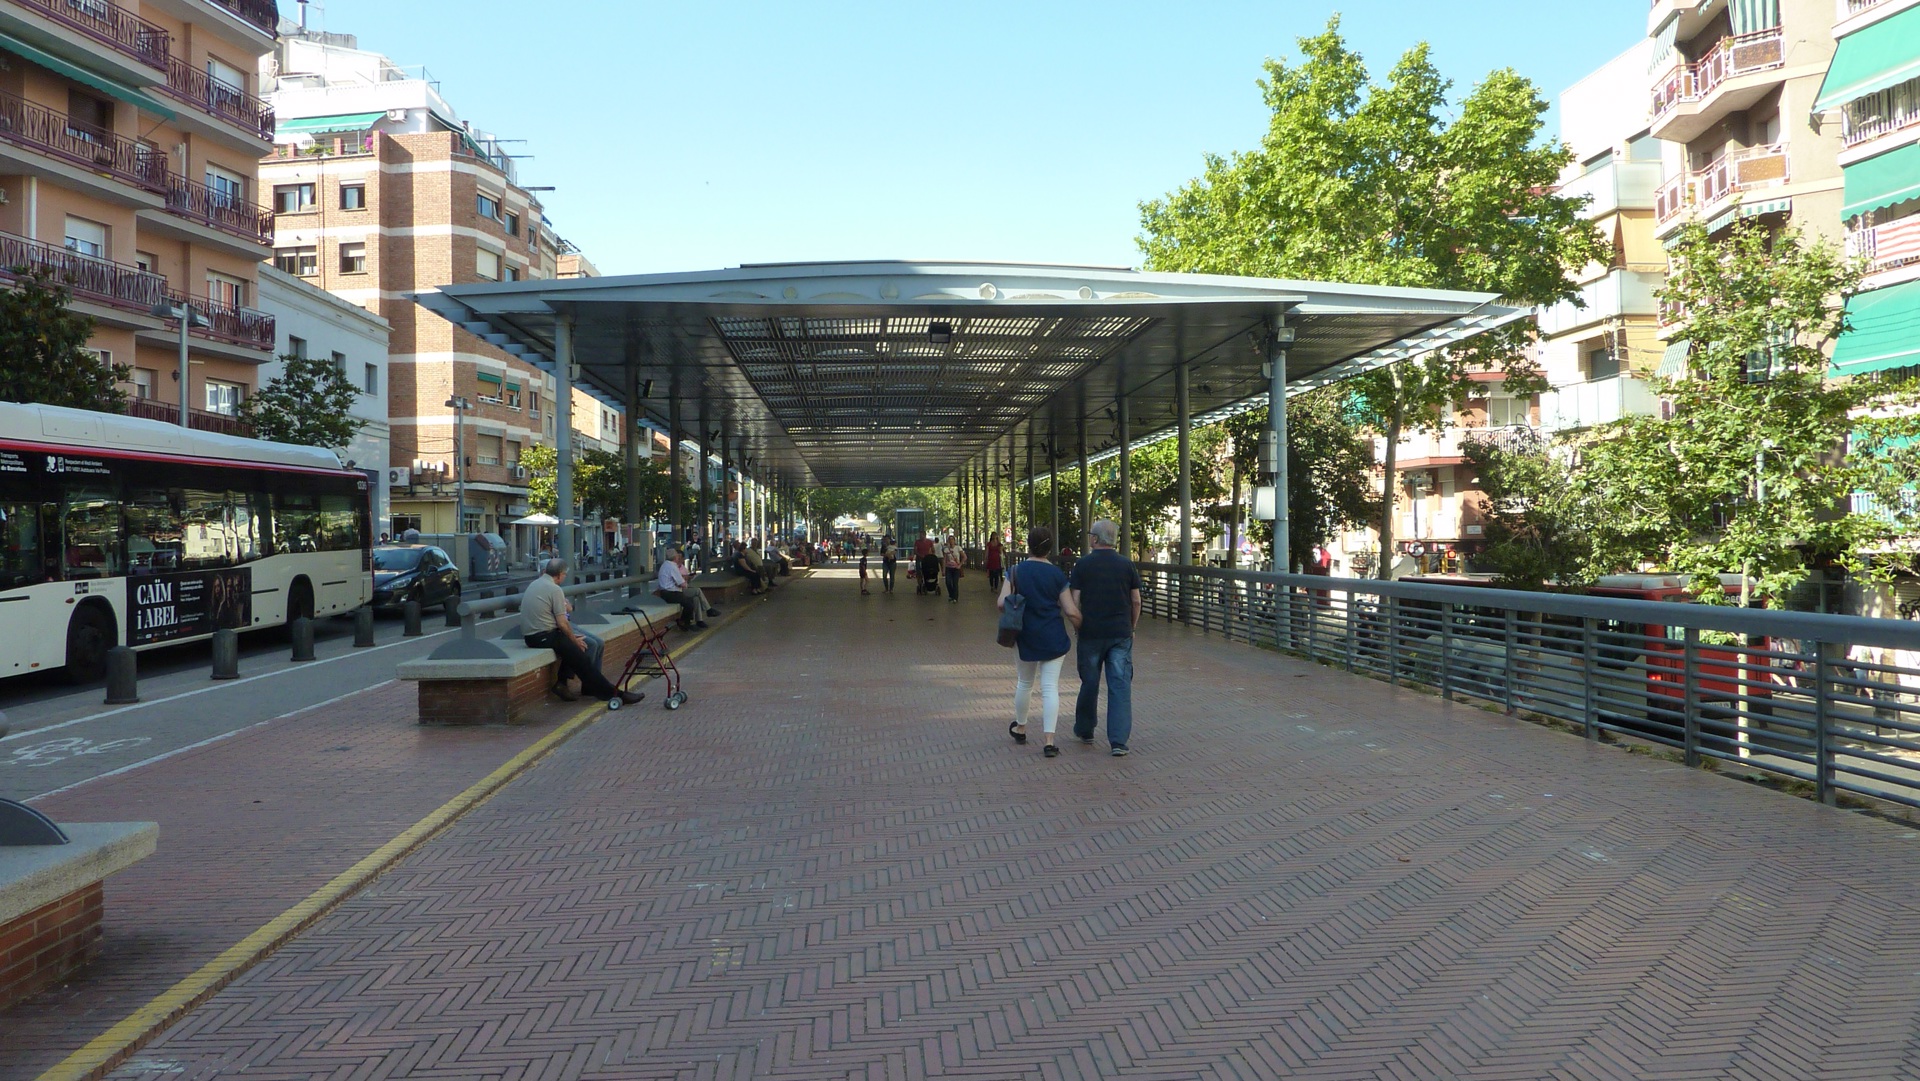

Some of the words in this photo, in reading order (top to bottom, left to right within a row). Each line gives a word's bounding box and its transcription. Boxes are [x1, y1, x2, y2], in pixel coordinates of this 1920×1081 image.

[136, 579, 172, 605] CAÏM
[137, 610, 142, 630] i
[144, 606, 178, 629] ABEL
